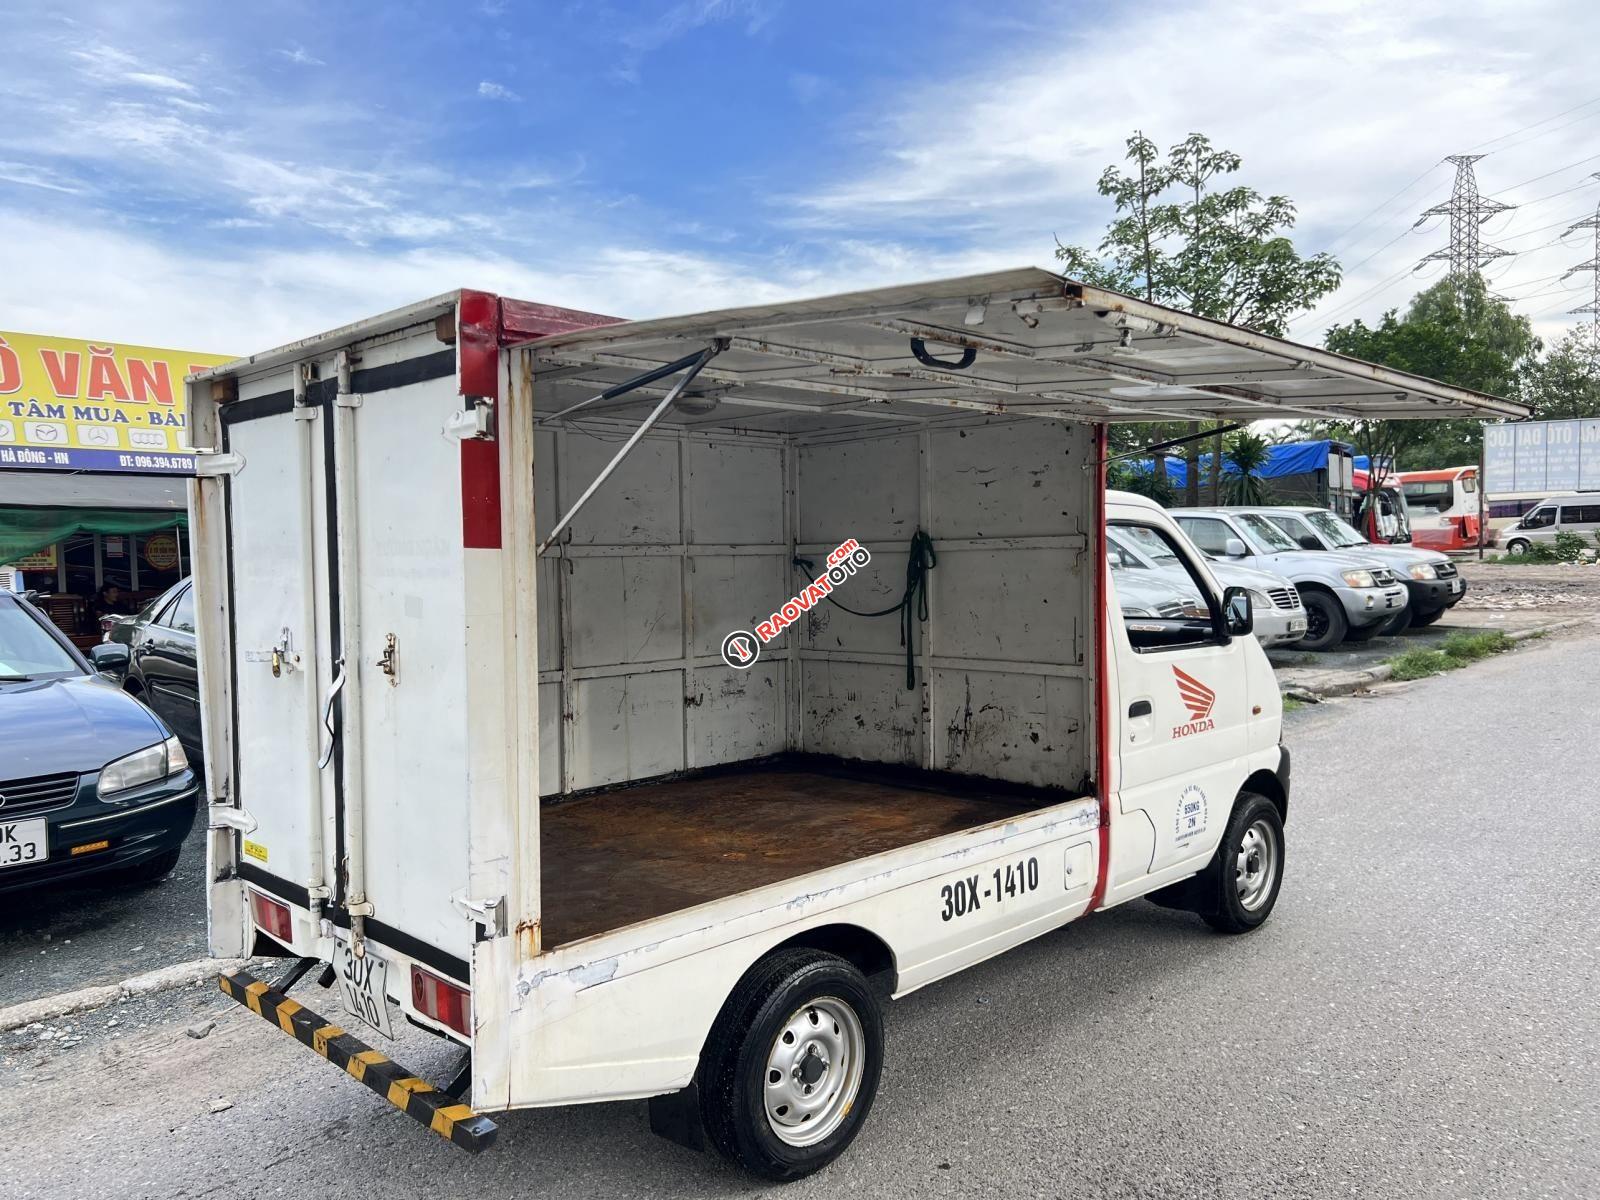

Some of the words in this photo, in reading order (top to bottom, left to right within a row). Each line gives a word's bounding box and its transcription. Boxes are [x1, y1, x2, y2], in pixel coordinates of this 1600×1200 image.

[39, 345, 175, 406] VĂN
[8, 399, 66, 419] TÂM
[73, 406, 130, 424] MUA
[1, 448, 17, 463] HÀ
[17, 449, 47, 464] ĐÔNG
[54, 452, 70, 465] HN
[119, 455, 134, 467] ĐT:
[135, 456, 193, 470] 096.394.6789
[1171, 718, 1215, 739] HONDA
[345, 983, 380, 1028] 1410
